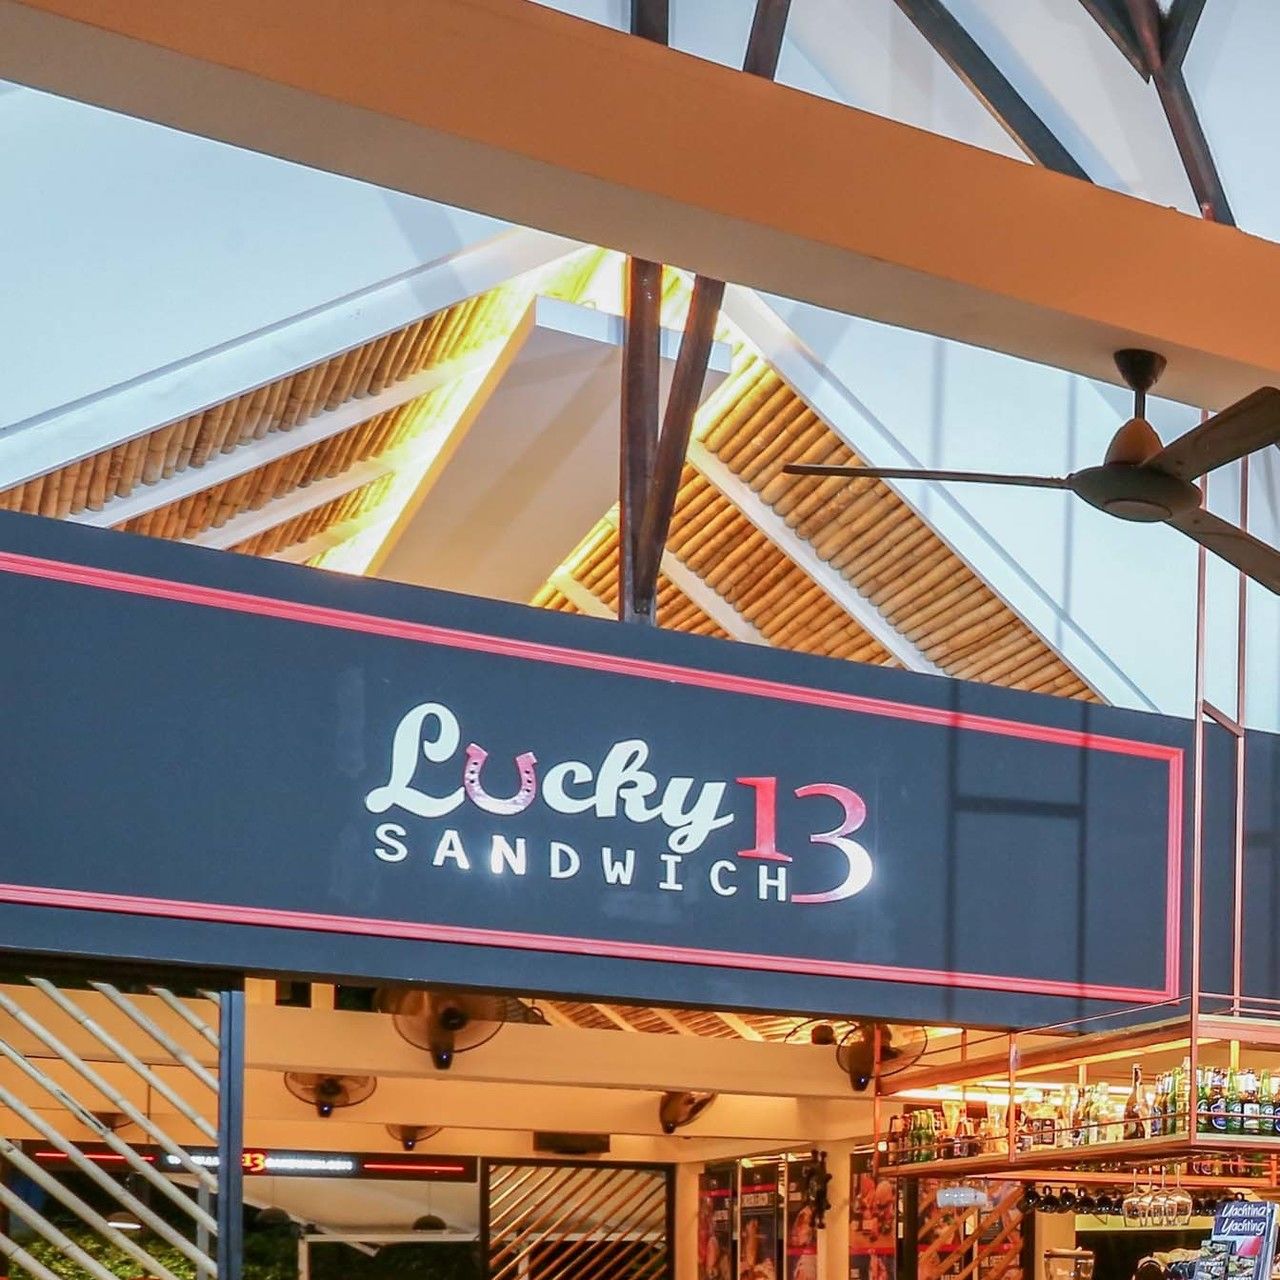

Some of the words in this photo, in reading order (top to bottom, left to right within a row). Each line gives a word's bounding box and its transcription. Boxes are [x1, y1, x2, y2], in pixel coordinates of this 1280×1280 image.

[364, 702, 735, 854] Lucky
[735, 776, 874, 904] 13
[374, 823, 789, 903] SANDWICH
[1221, 1217, 1267, 1236] Yachting
